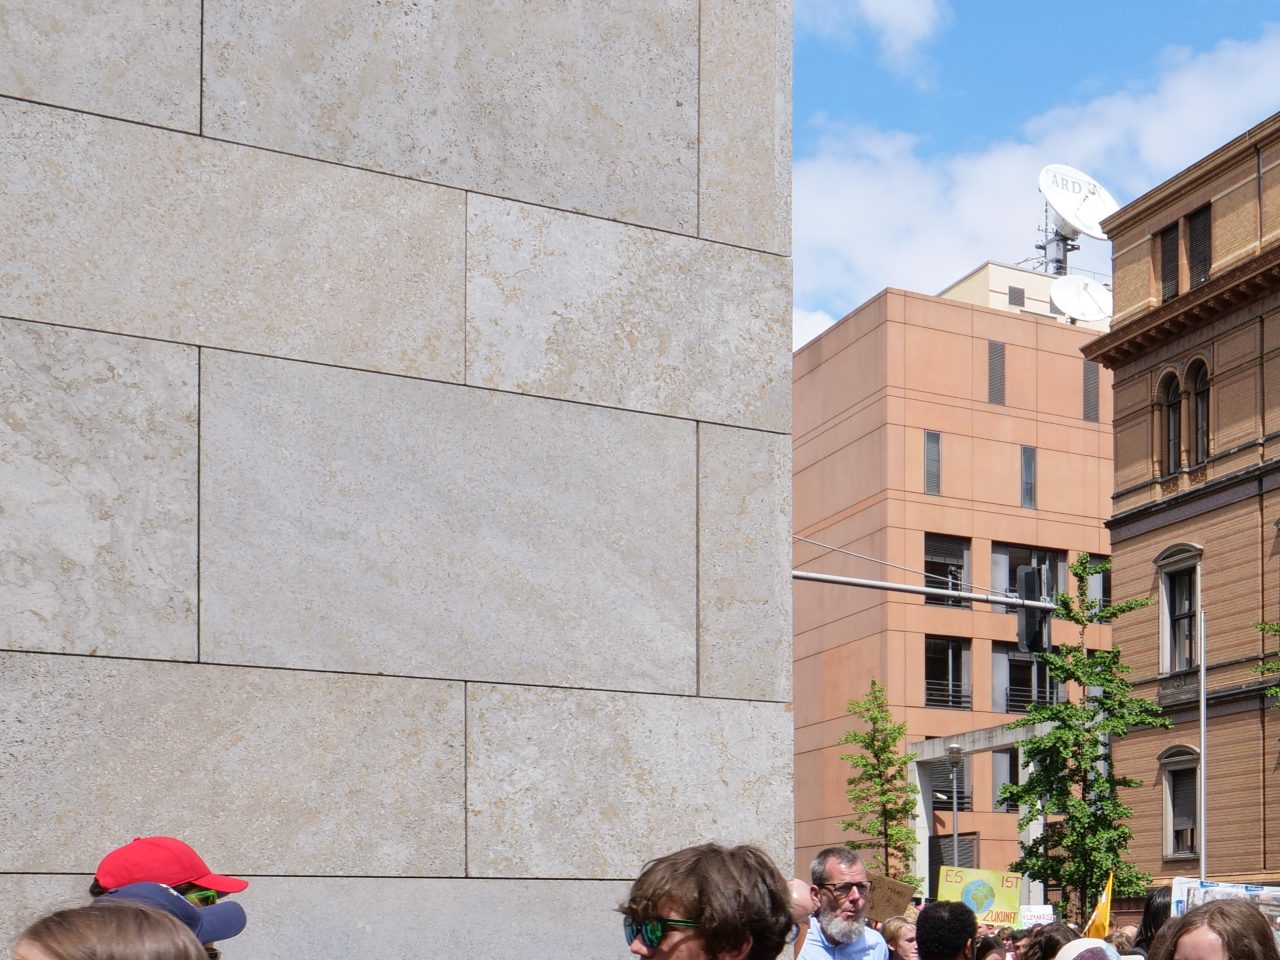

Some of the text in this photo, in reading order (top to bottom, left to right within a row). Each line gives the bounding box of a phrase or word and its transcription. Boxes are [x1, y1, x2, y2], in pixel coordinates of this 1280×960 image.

[1051, 173, 1083, 194] ARD
[945, 869, 1024, 889] ES IST
